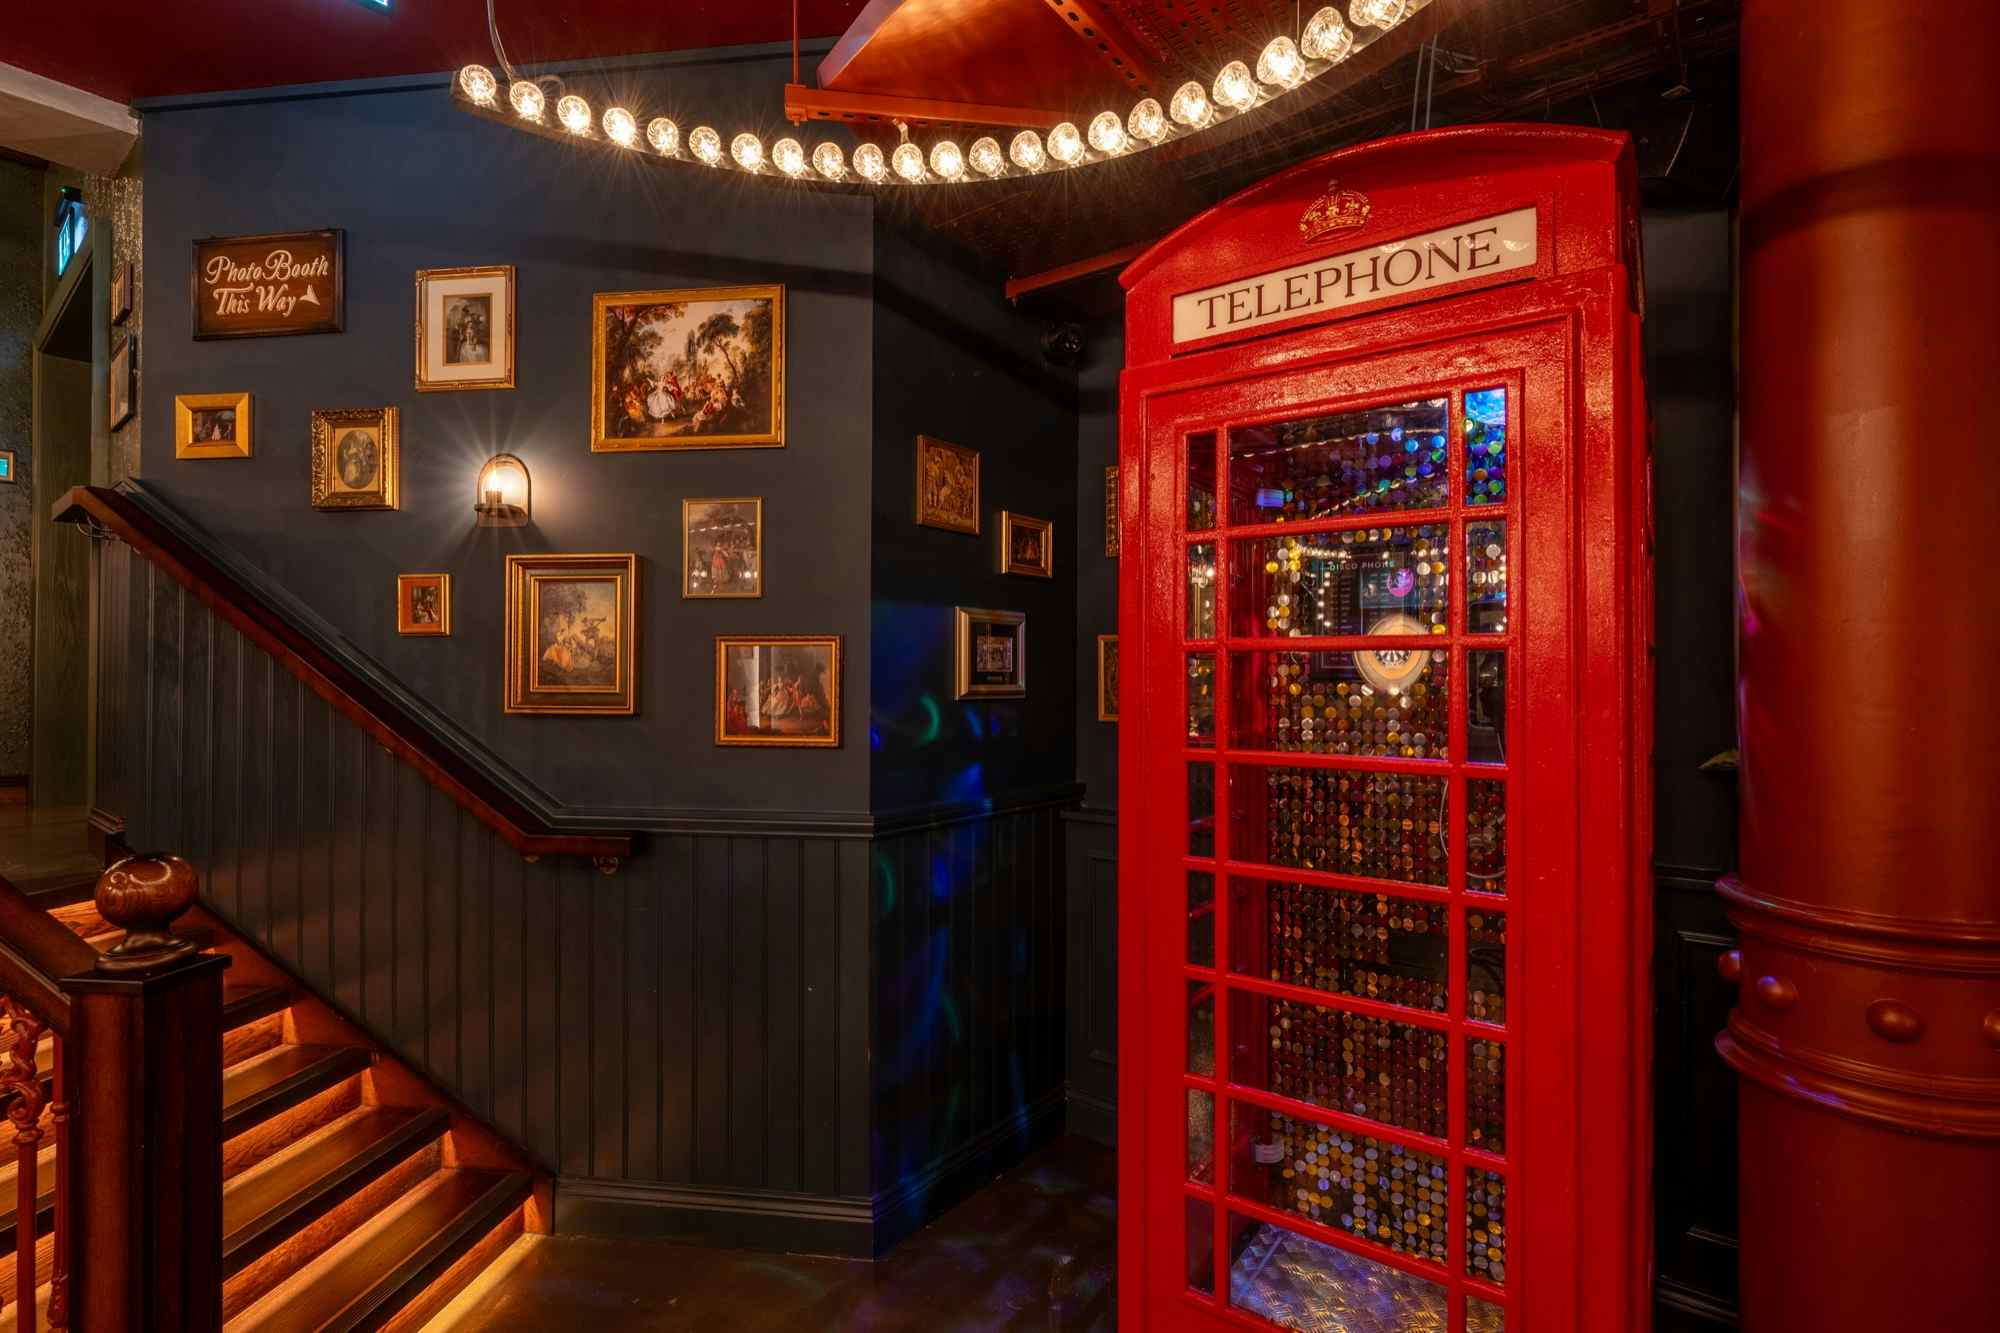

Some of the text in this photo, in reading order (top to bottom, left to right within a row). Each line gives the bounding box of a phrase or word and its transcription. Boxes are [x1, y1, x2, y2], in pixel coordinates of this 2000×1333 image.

[205, 249, 328, 285] Photo Booth
[1198, 227, 1500, 330] TELEPHONE
[213, 282, 297, 318] This Way
[1329, 560, 1395, 571] DISCO PHONE
